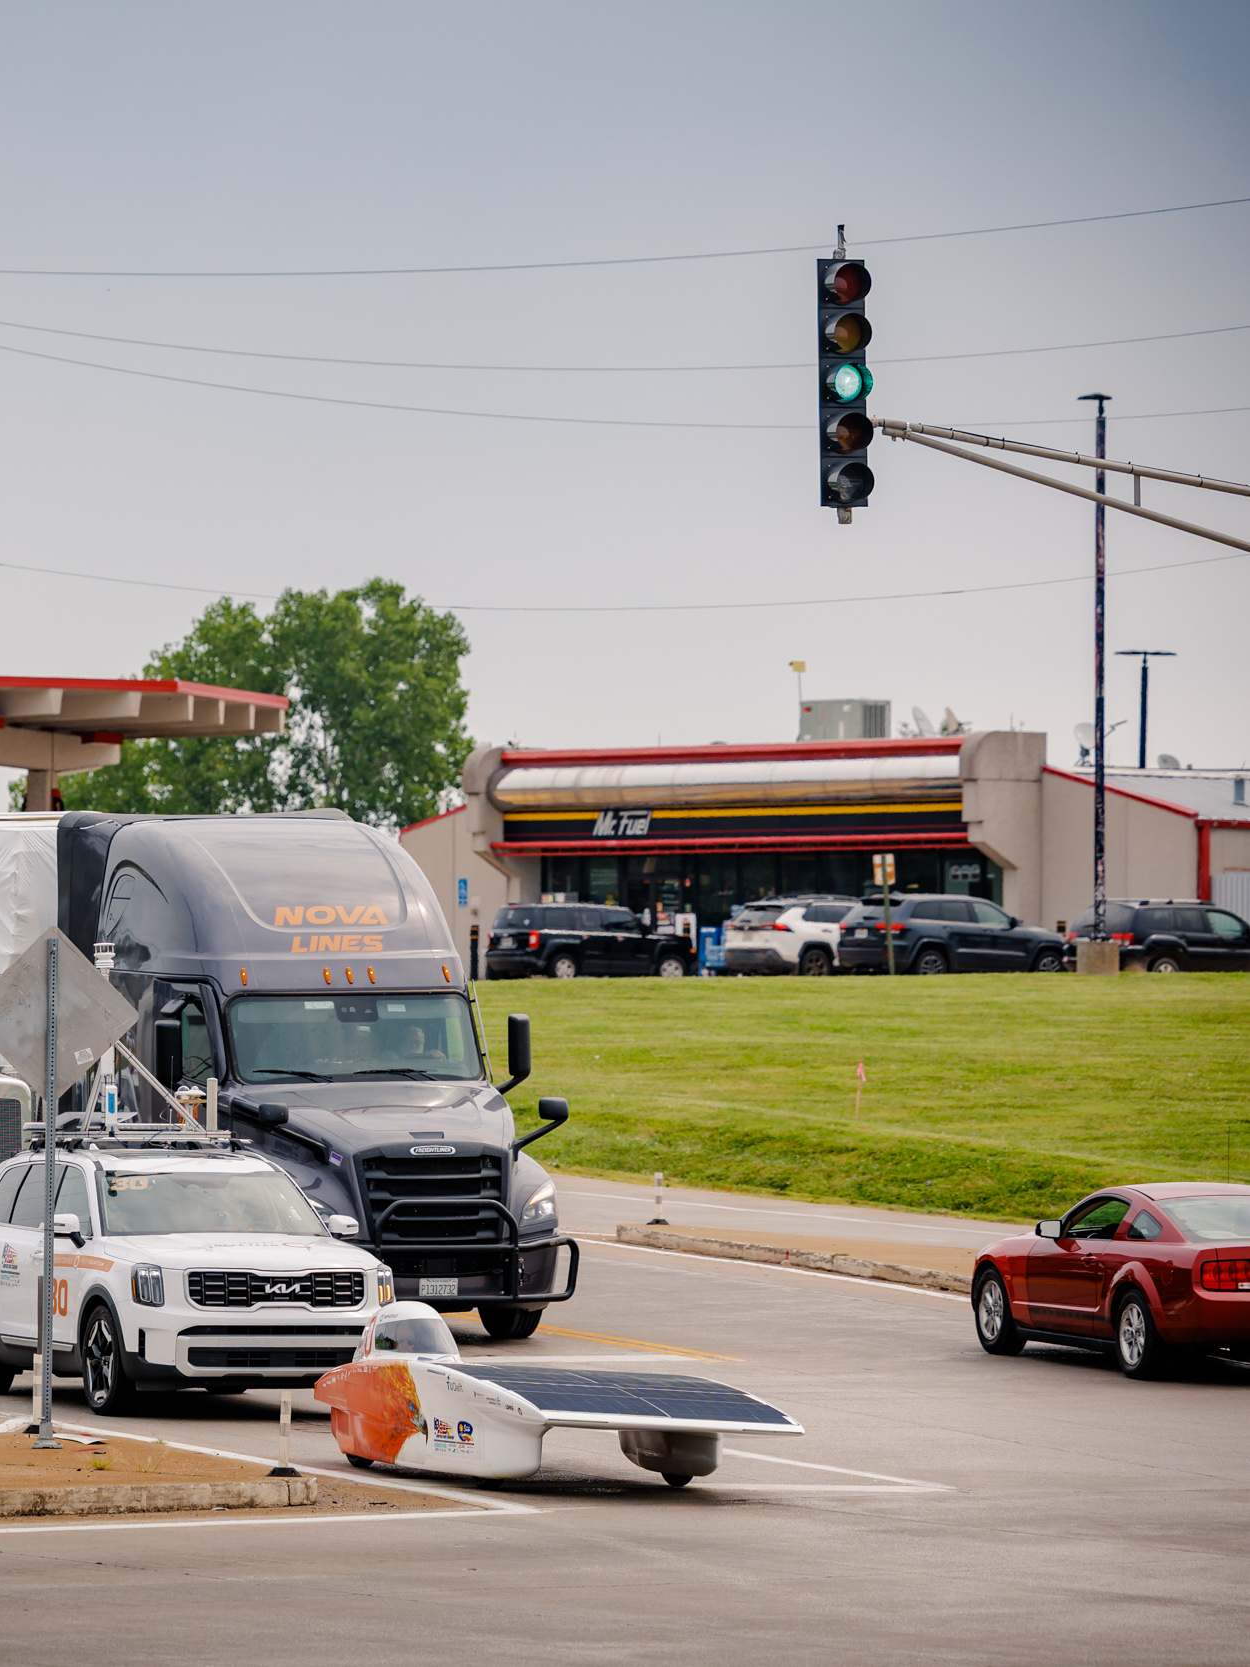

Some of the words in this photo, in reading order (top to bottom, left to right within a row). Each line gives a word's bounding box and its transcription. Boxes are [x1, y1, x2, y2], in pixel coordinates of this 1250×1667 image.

[617, 810, 652, 836] Fuel
[274, 905, 390, 927] NOVA
[291, 934, 385, 954] LINES
[111, 1176, 149, 1191] 30
[421, 1284, 456, 1295] P1312732
